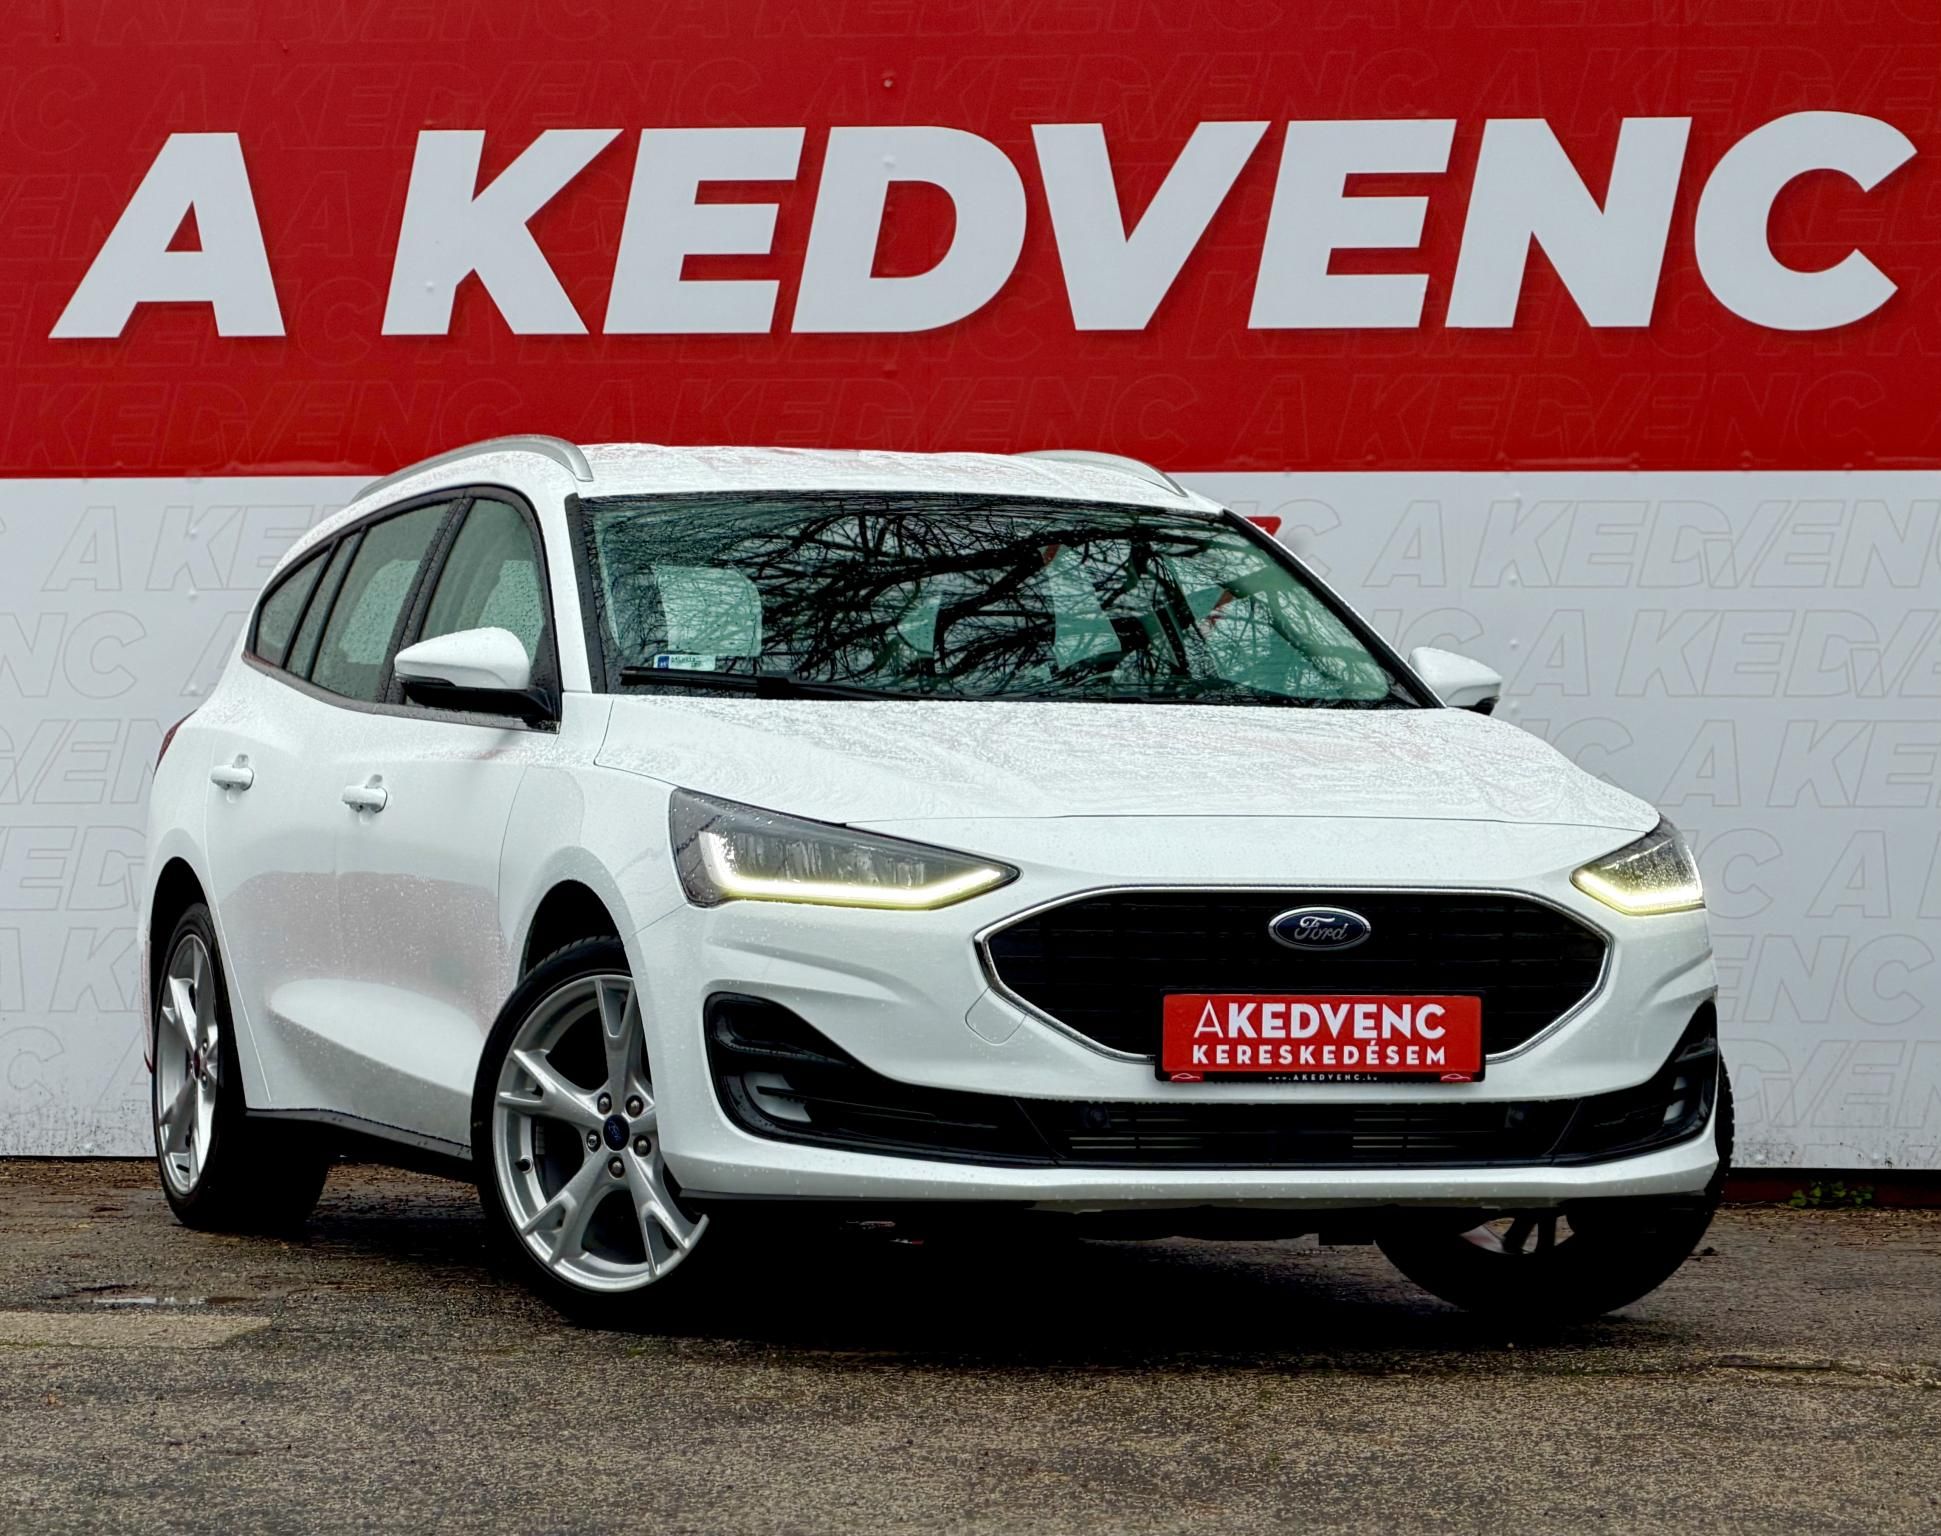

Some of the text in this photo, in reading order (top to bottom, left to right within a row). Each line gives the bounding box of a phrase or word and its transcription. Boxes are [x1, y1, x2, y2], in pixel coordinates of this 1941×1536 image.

[48, 132, 287, 339] A
[381, 110, 1918, 336] KEDVENC
[1362, 499, 1448, 588] A
[1470, 500, 1941, 589] KEDVEN
[1505, 610, 1590, 697] A
[1655, 719, 1742, 807] A
[1294, 916, 1348, 940] Ford
[1192, 1040, 1446, 1065] KERESKEDÉSEM
